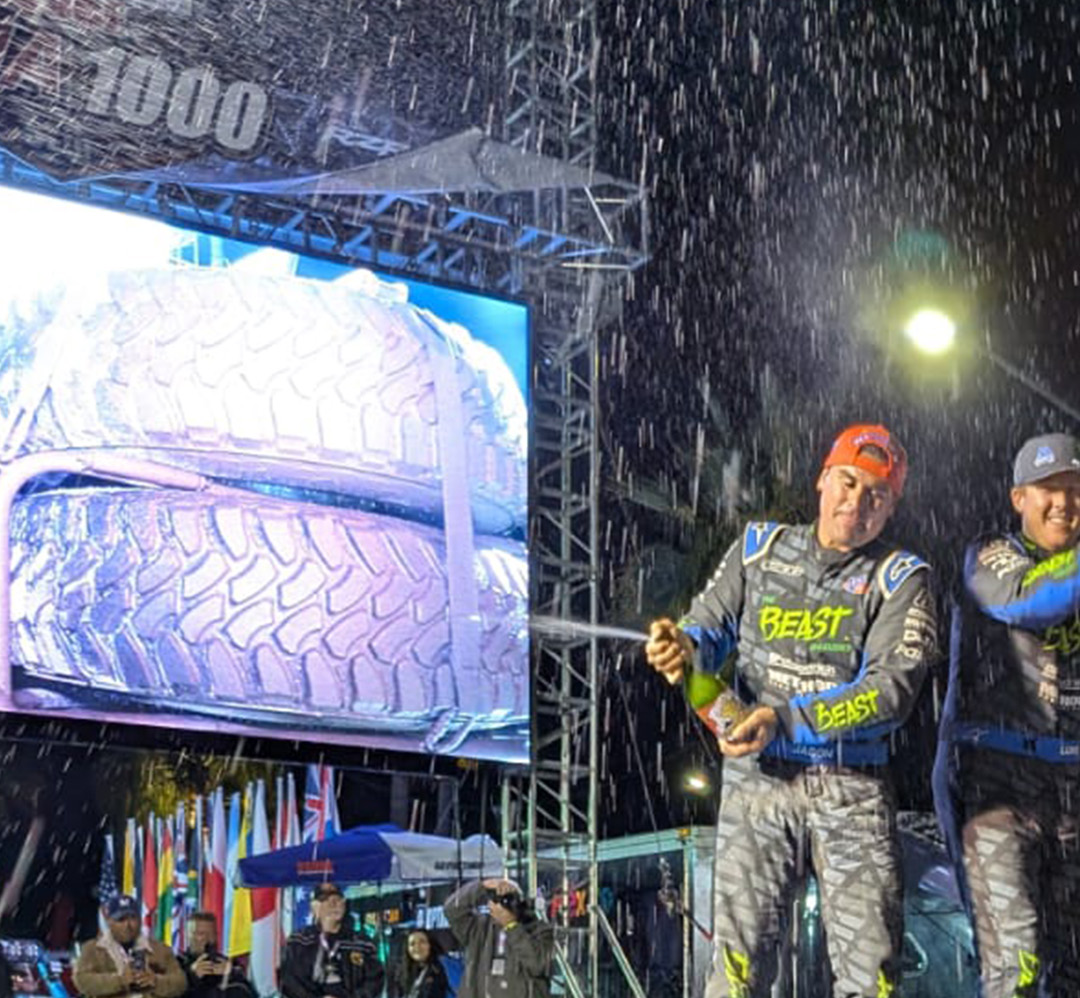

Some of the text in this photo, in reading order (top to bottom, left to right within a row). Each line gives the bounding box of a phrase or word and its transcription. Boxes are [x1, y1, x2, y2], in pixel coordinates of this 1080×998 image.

[86, 46, 270, 152] 1000
[759, 605, 853, 641] BEAST
[814, 690, 880, 733] BEAST
